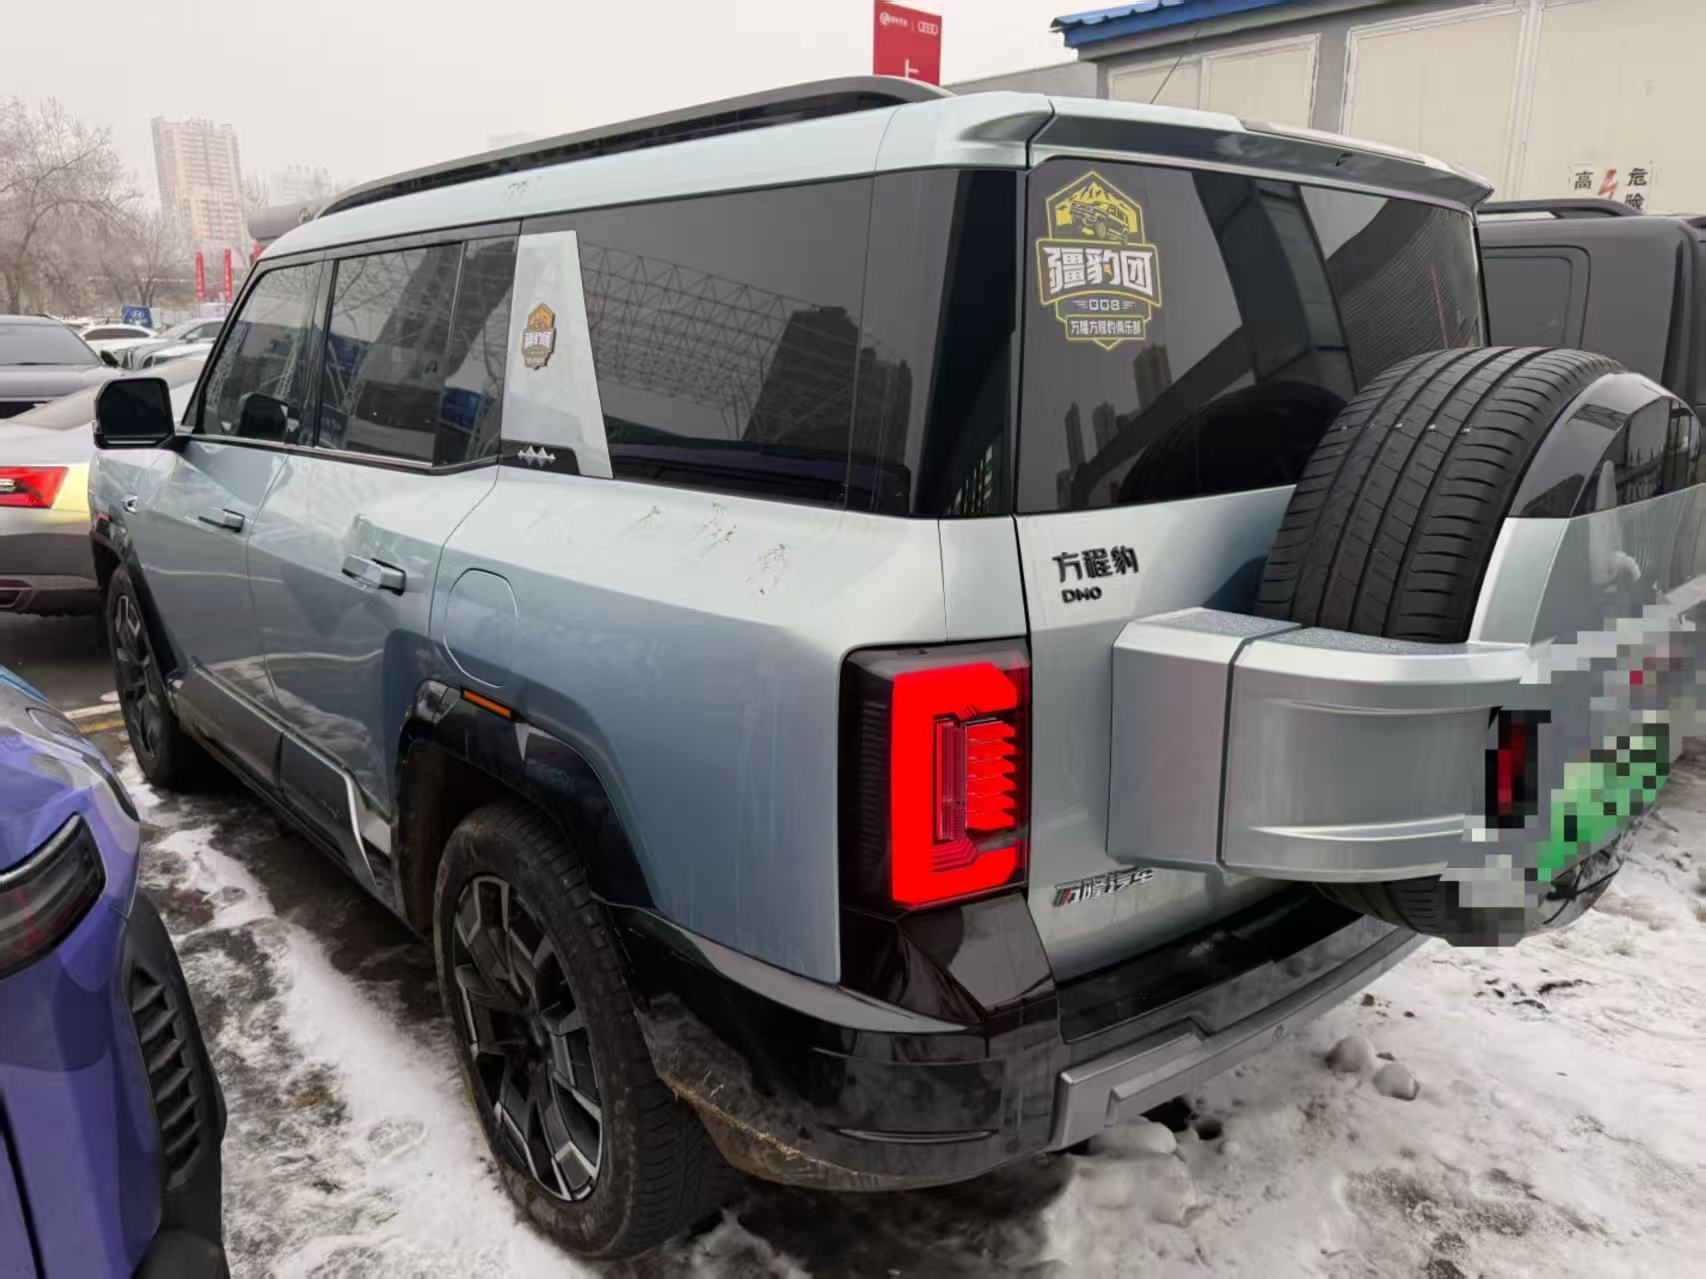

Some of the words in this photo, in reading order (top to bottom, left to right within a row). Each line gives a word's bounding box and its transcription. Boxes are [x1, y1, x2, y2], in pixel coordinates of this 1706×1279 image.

[1574, 171, 1595, 190] 高
[1043, 247, 1153, 296] 疆豹团
[1052, 545, 1140, 583] 方程豹
[1061, 586, 1103, 603] DMO
